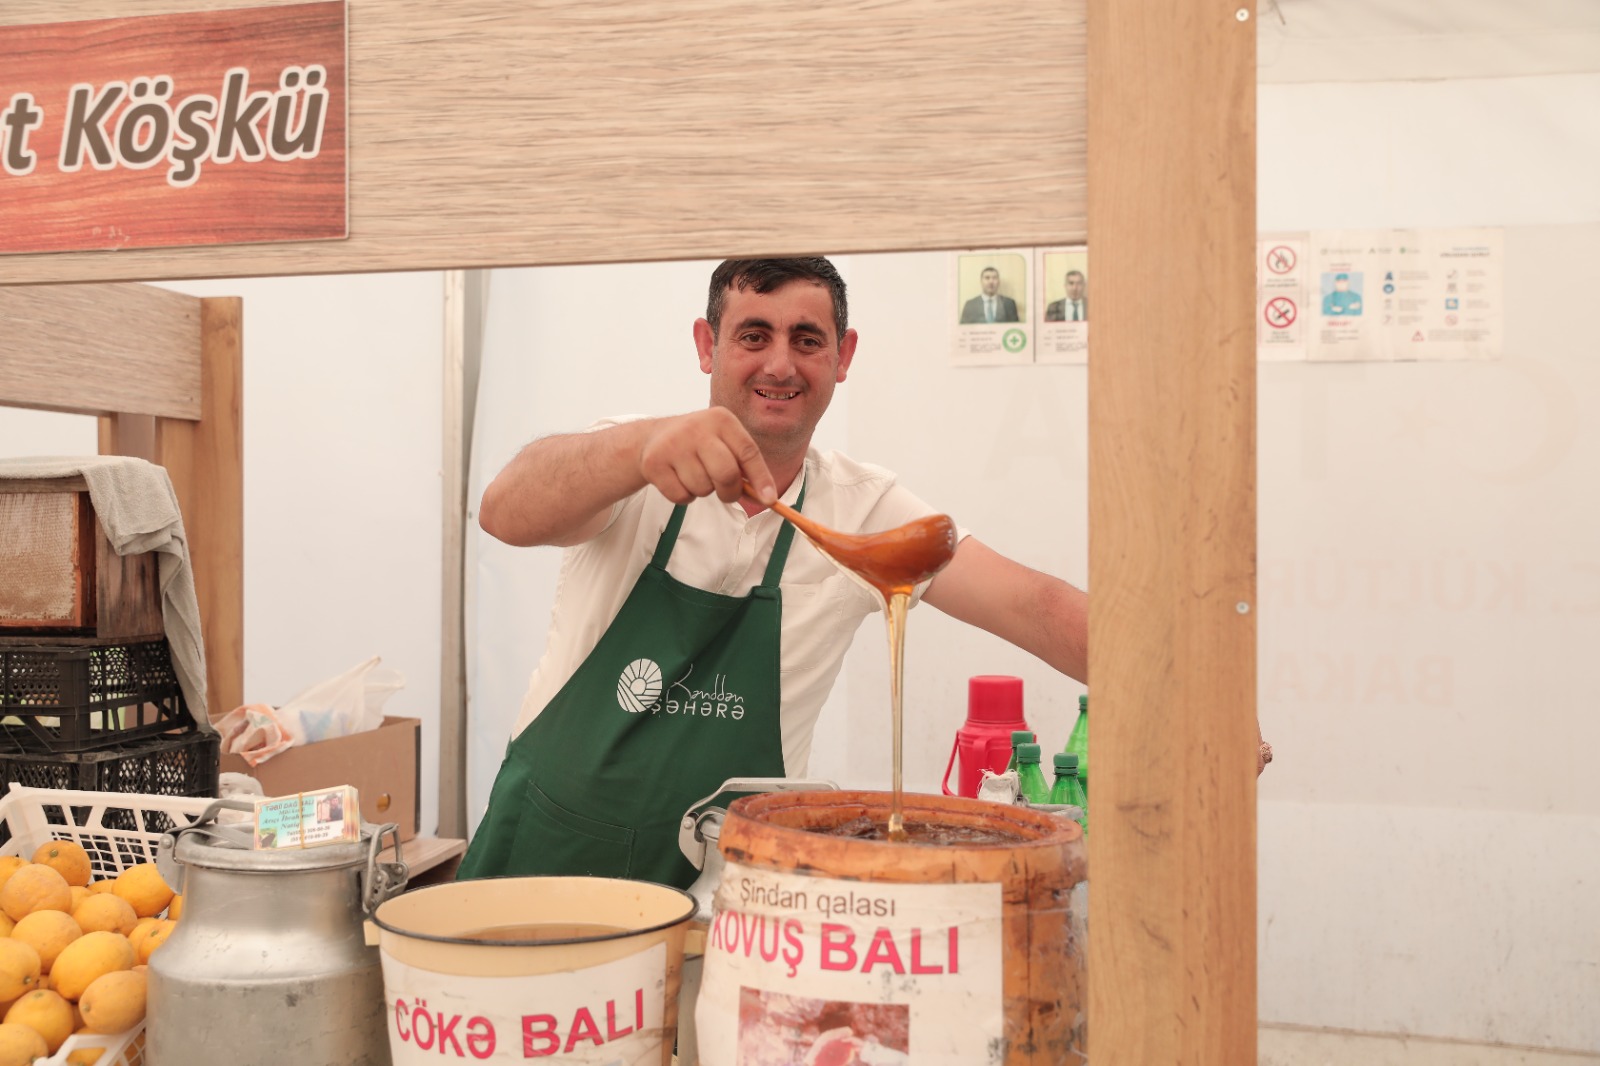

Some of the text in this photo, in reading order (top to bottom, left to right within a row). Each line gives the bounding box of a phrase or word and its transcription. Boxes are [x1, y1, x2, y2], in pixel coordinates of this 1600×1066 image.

[0, 64, 330, 187] t Köşkü
[740, 878, 896, 920] Şindan qalası
[711, 909, 959, 978] KOVUŞ BALI
[395, 988, 643, 1059] CÖKƏ BALI
